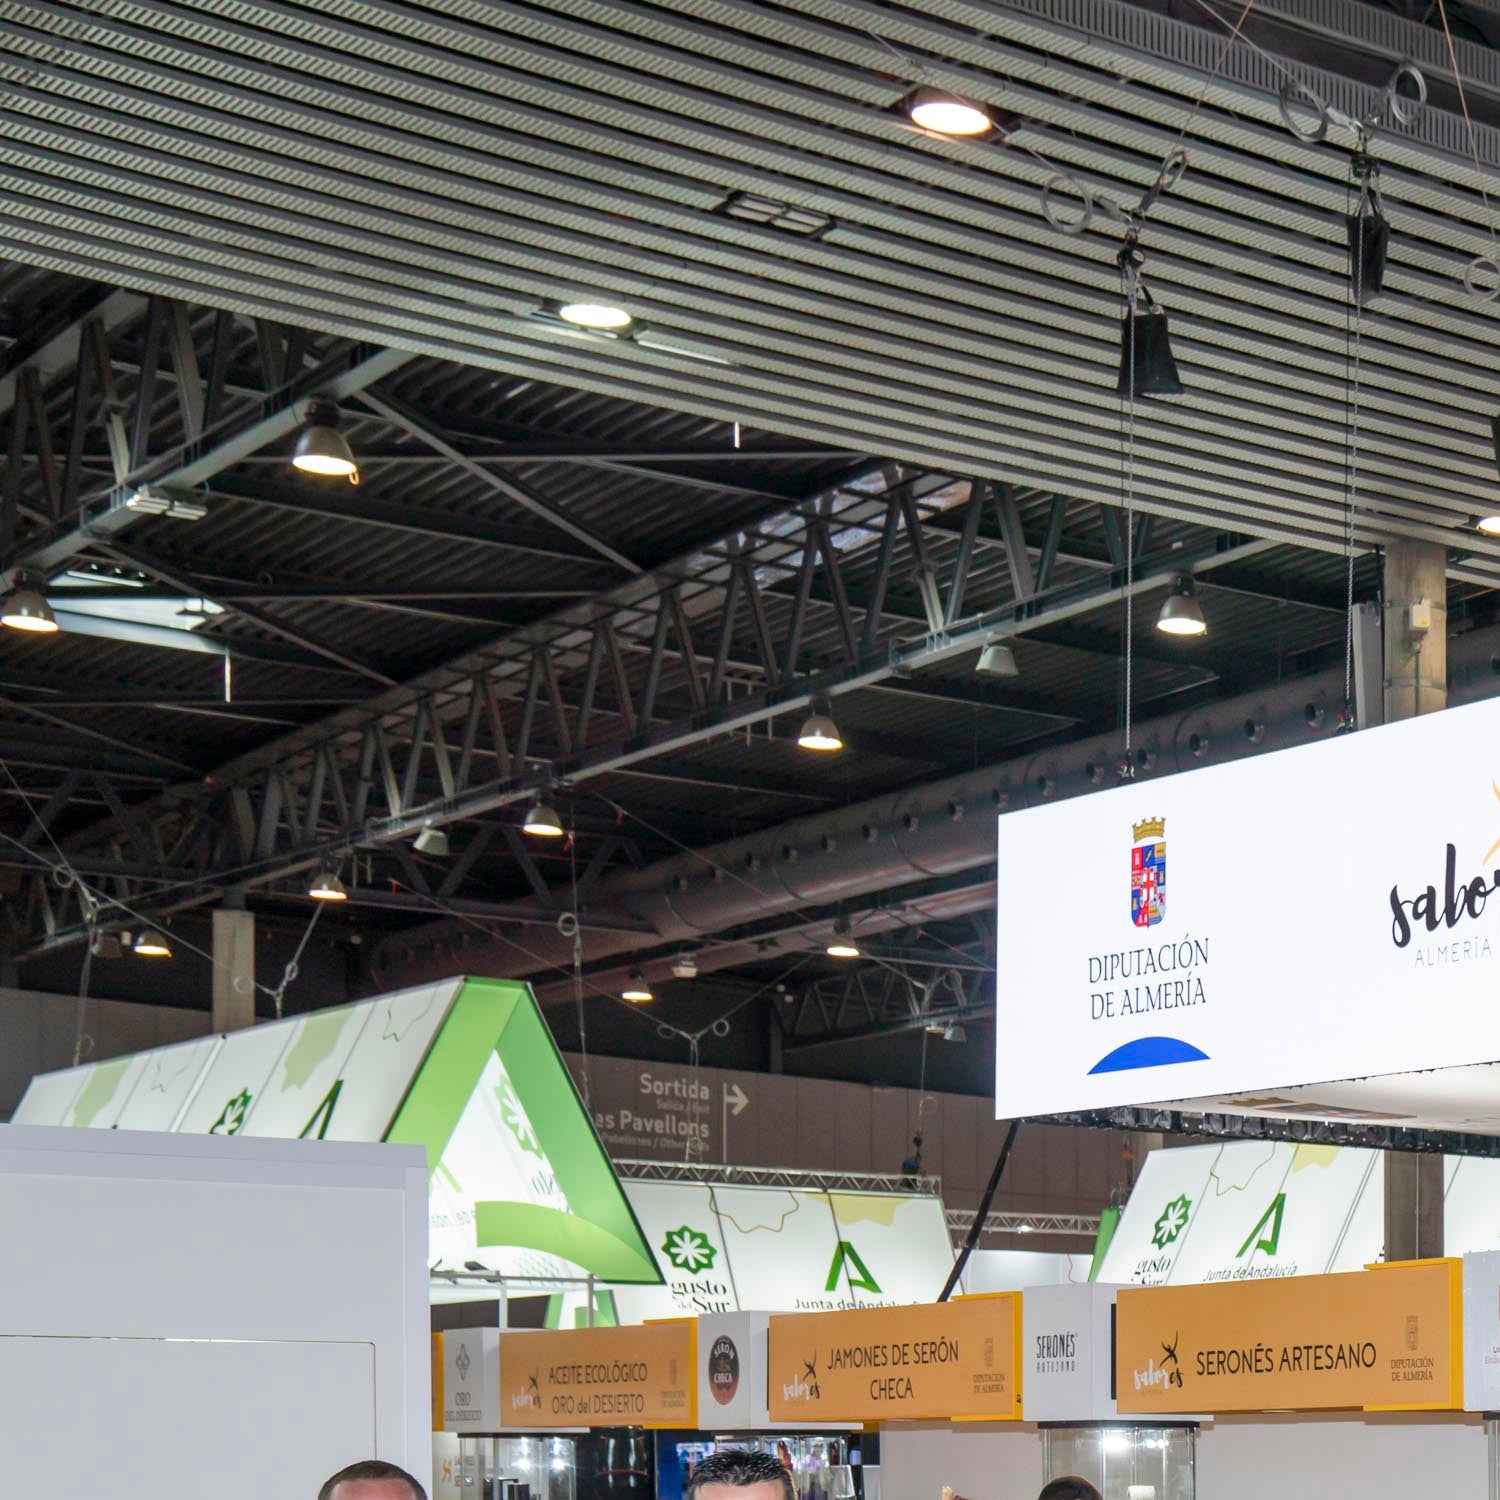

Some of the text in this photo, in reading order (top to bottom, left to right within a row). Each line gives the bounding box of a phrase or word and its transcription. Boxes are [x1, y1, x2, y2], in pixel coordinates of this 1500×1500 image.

[1087, 935, 1209, 984] DIPUTACIÓN
[1414, 936, 1492, 968] ALMERÍA
[1090, 973, 1207, 1021] DE ALMERÍA
[640, 1073, 710, 1100] Sortida
[620, 1110, 710, 1138] Pavellons
[1203, 1260, 1298, 1283] Junta de Andalucía
[671, 1279, 728, 1300] gusto
[794, 1298, 834, 1310] Junta
[826, 1336, 959, 1371] JAMONES DE SERÓN
[1036, 1332, 1075, 1359] SERONÉS
[549, 1359, 648, 1385] ACEITE ECOLÓGICO
[1197, 1342, 1377, 1376] SERONÉS ARTESANO
[1390, 1356, 1434, 1369] DIPUTACIÓN
[1392, 1370, 1433, 1382] DE ALMERÍA
[455, 1391, 471, 1406] ORO
[869, 1378, 914, 1401] CHECA
[552, 1396, 574, 1415] ORO
[577, 1397, 590, 1414] del
[593, 1393, 645, 1414] DESIERTO
